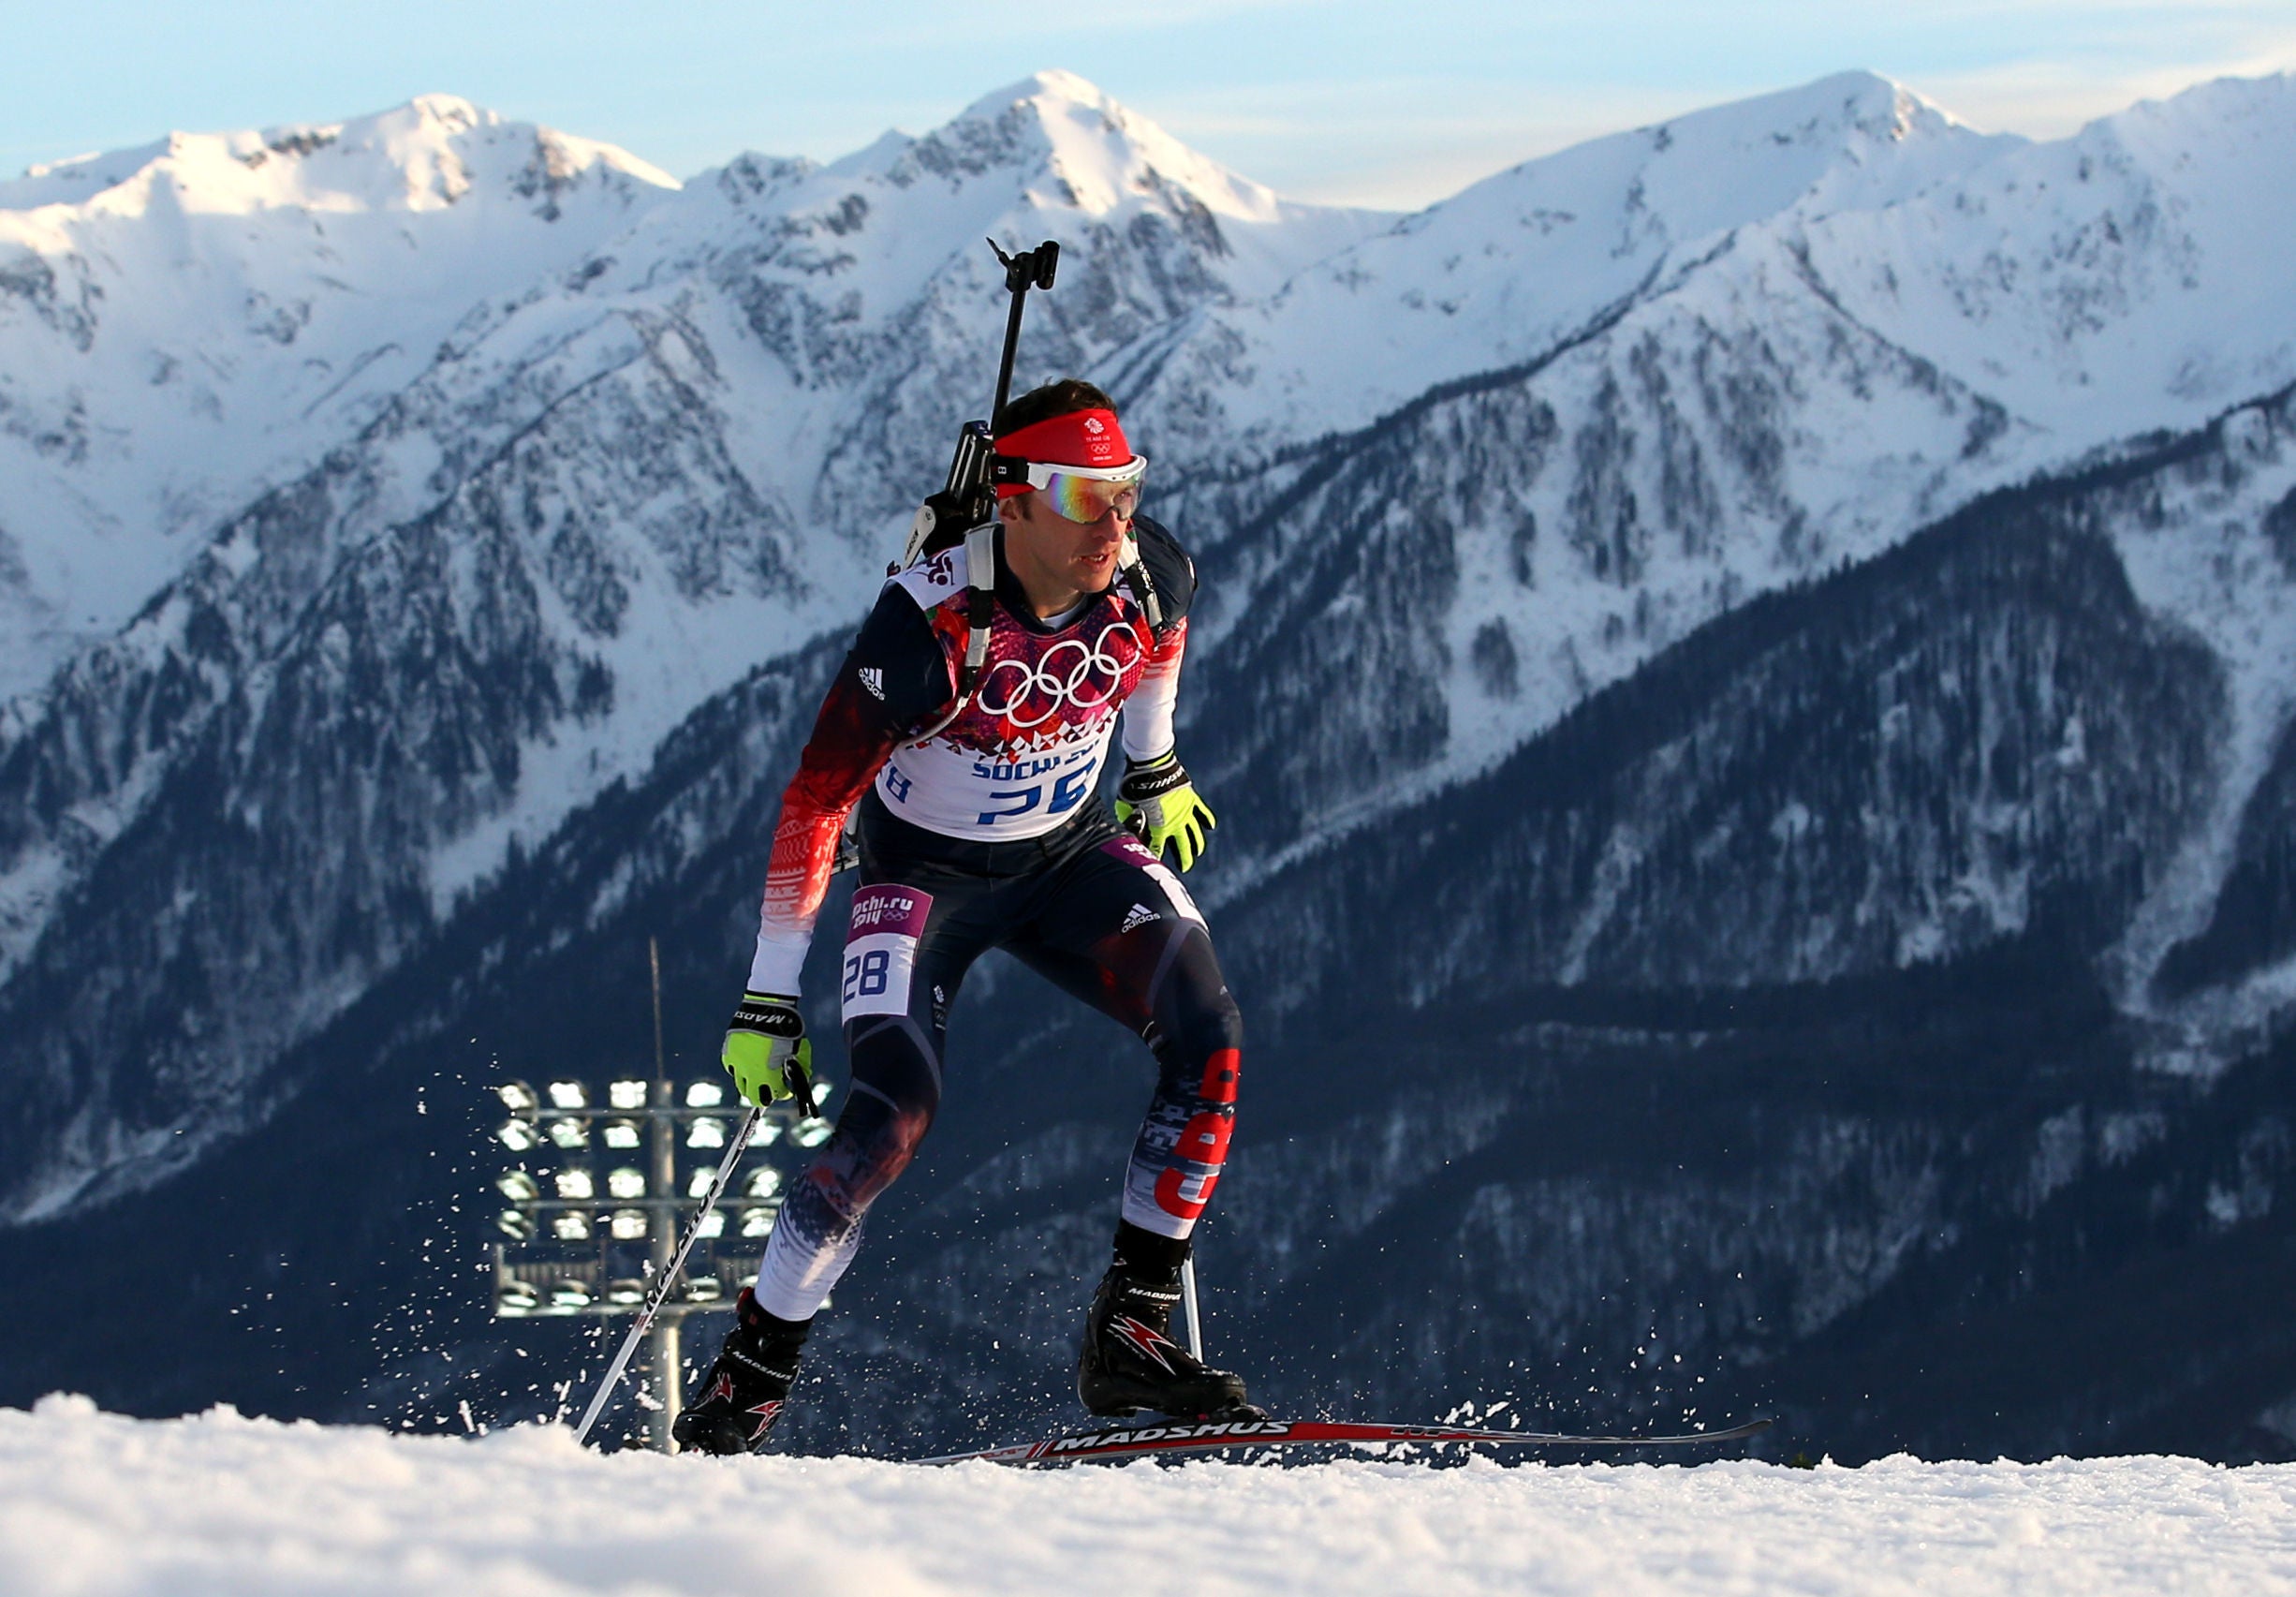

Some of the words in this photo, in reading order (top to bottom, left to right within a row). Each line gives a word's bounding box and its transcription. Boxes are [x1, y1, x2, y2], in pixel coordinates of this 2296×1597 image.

[859, 668, 885, 701] adidas
[972, 756, 1060, 780] SOCHI
[852, 895, 914, 919] ochi.ru
[1122, 913, 1161, 933] adidas
[843, 950, 890, 1004] 28
[733, 1011, 786, 1024] MADS
[732, 1351, 793, 1382] MADSHUS
[1053, 1421, 1294, 1451] MADSHUS
